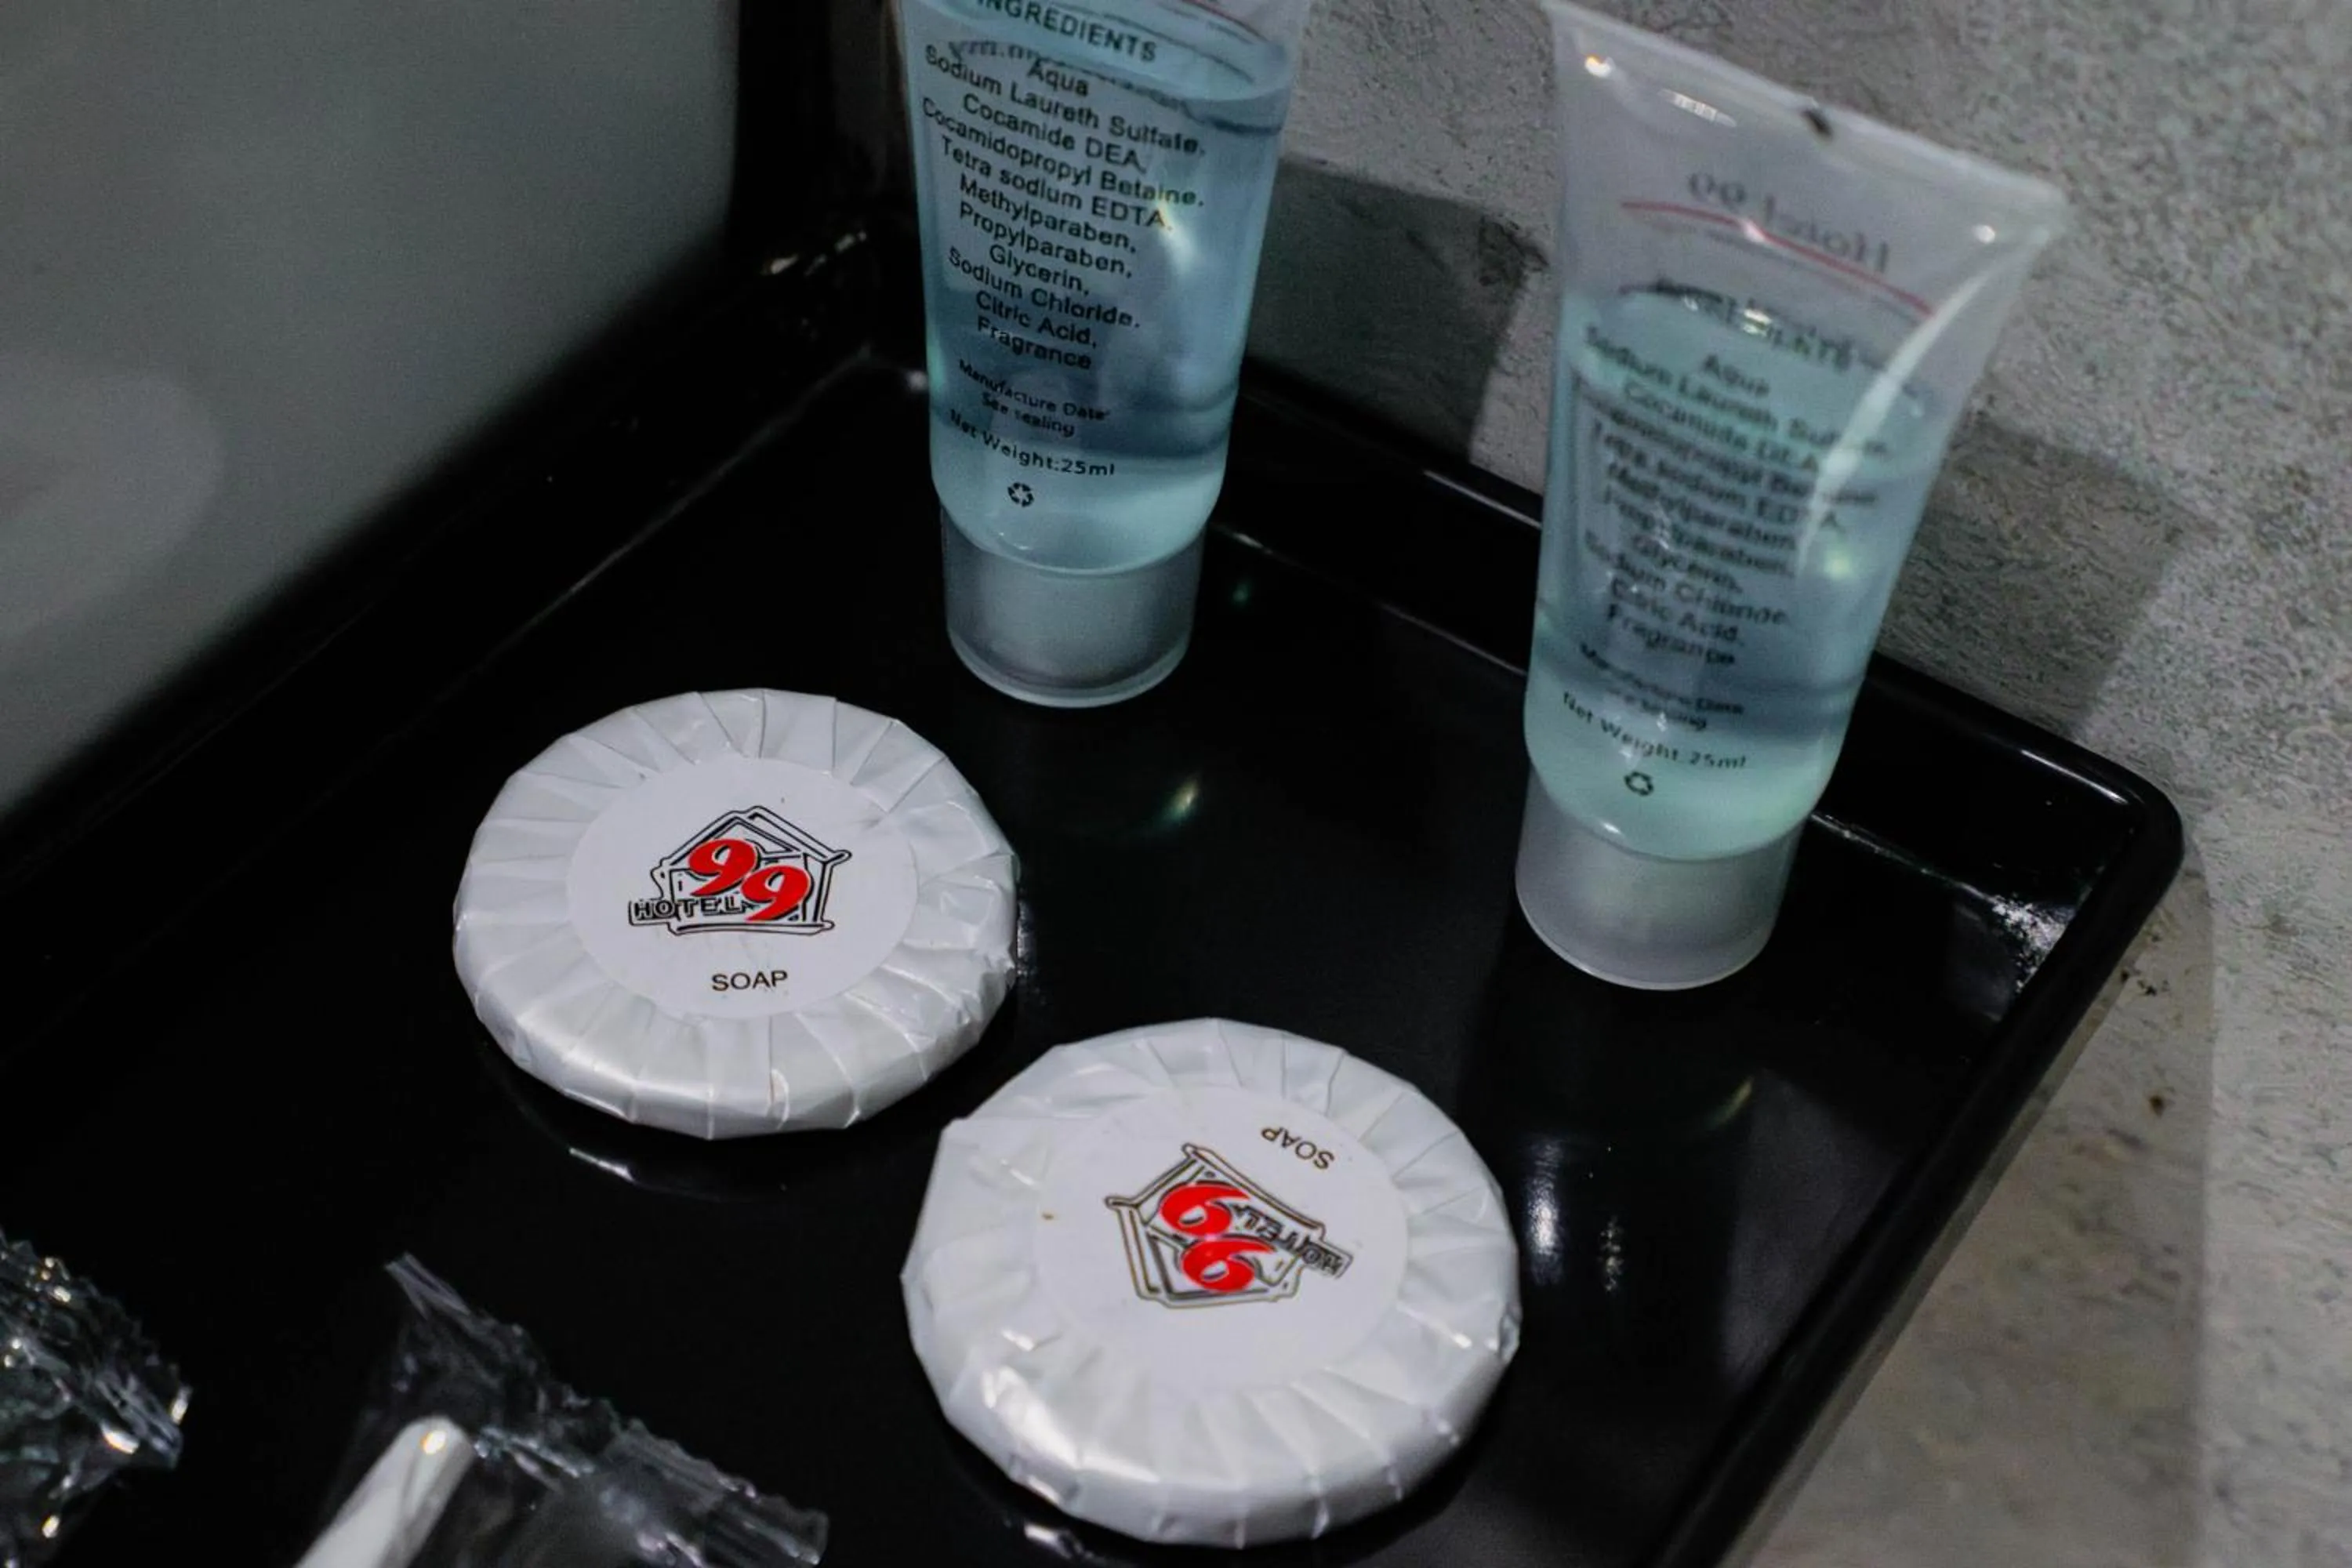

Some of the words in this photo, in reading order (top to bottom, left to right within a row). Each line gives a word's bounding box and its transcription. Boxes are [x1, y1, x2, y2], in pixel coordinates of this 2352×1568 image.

[925, 44, 1002, 96] Sodium
[1011, 79, 1100, 129] Laureth
[1026, 55, 1090, 97] Aqua
[922, 96, 1093, 187] Cocamidopropyl
[963, 93, 1076, 151] Cocamide
[942, 134, 992, 178] Tetra
[999, 169, 1083, 210] sodium
[949, 245, 1023, 299] Sodium
[989, 244, 1090, 296] Glycerin,
[975, 289, 1032, 328] Citric
[977, 314, 1091, 370] Fragrance
[958, 358, 1057, 412] Manufacture
[949, 408, 978, 439] Net
[688, 839, 811, 923] 99
[633, 898, 742, 922] HOTEL
[711, 970, 788, 991] SOAP
[1261, 1127, 1334, 1170] SOAP
